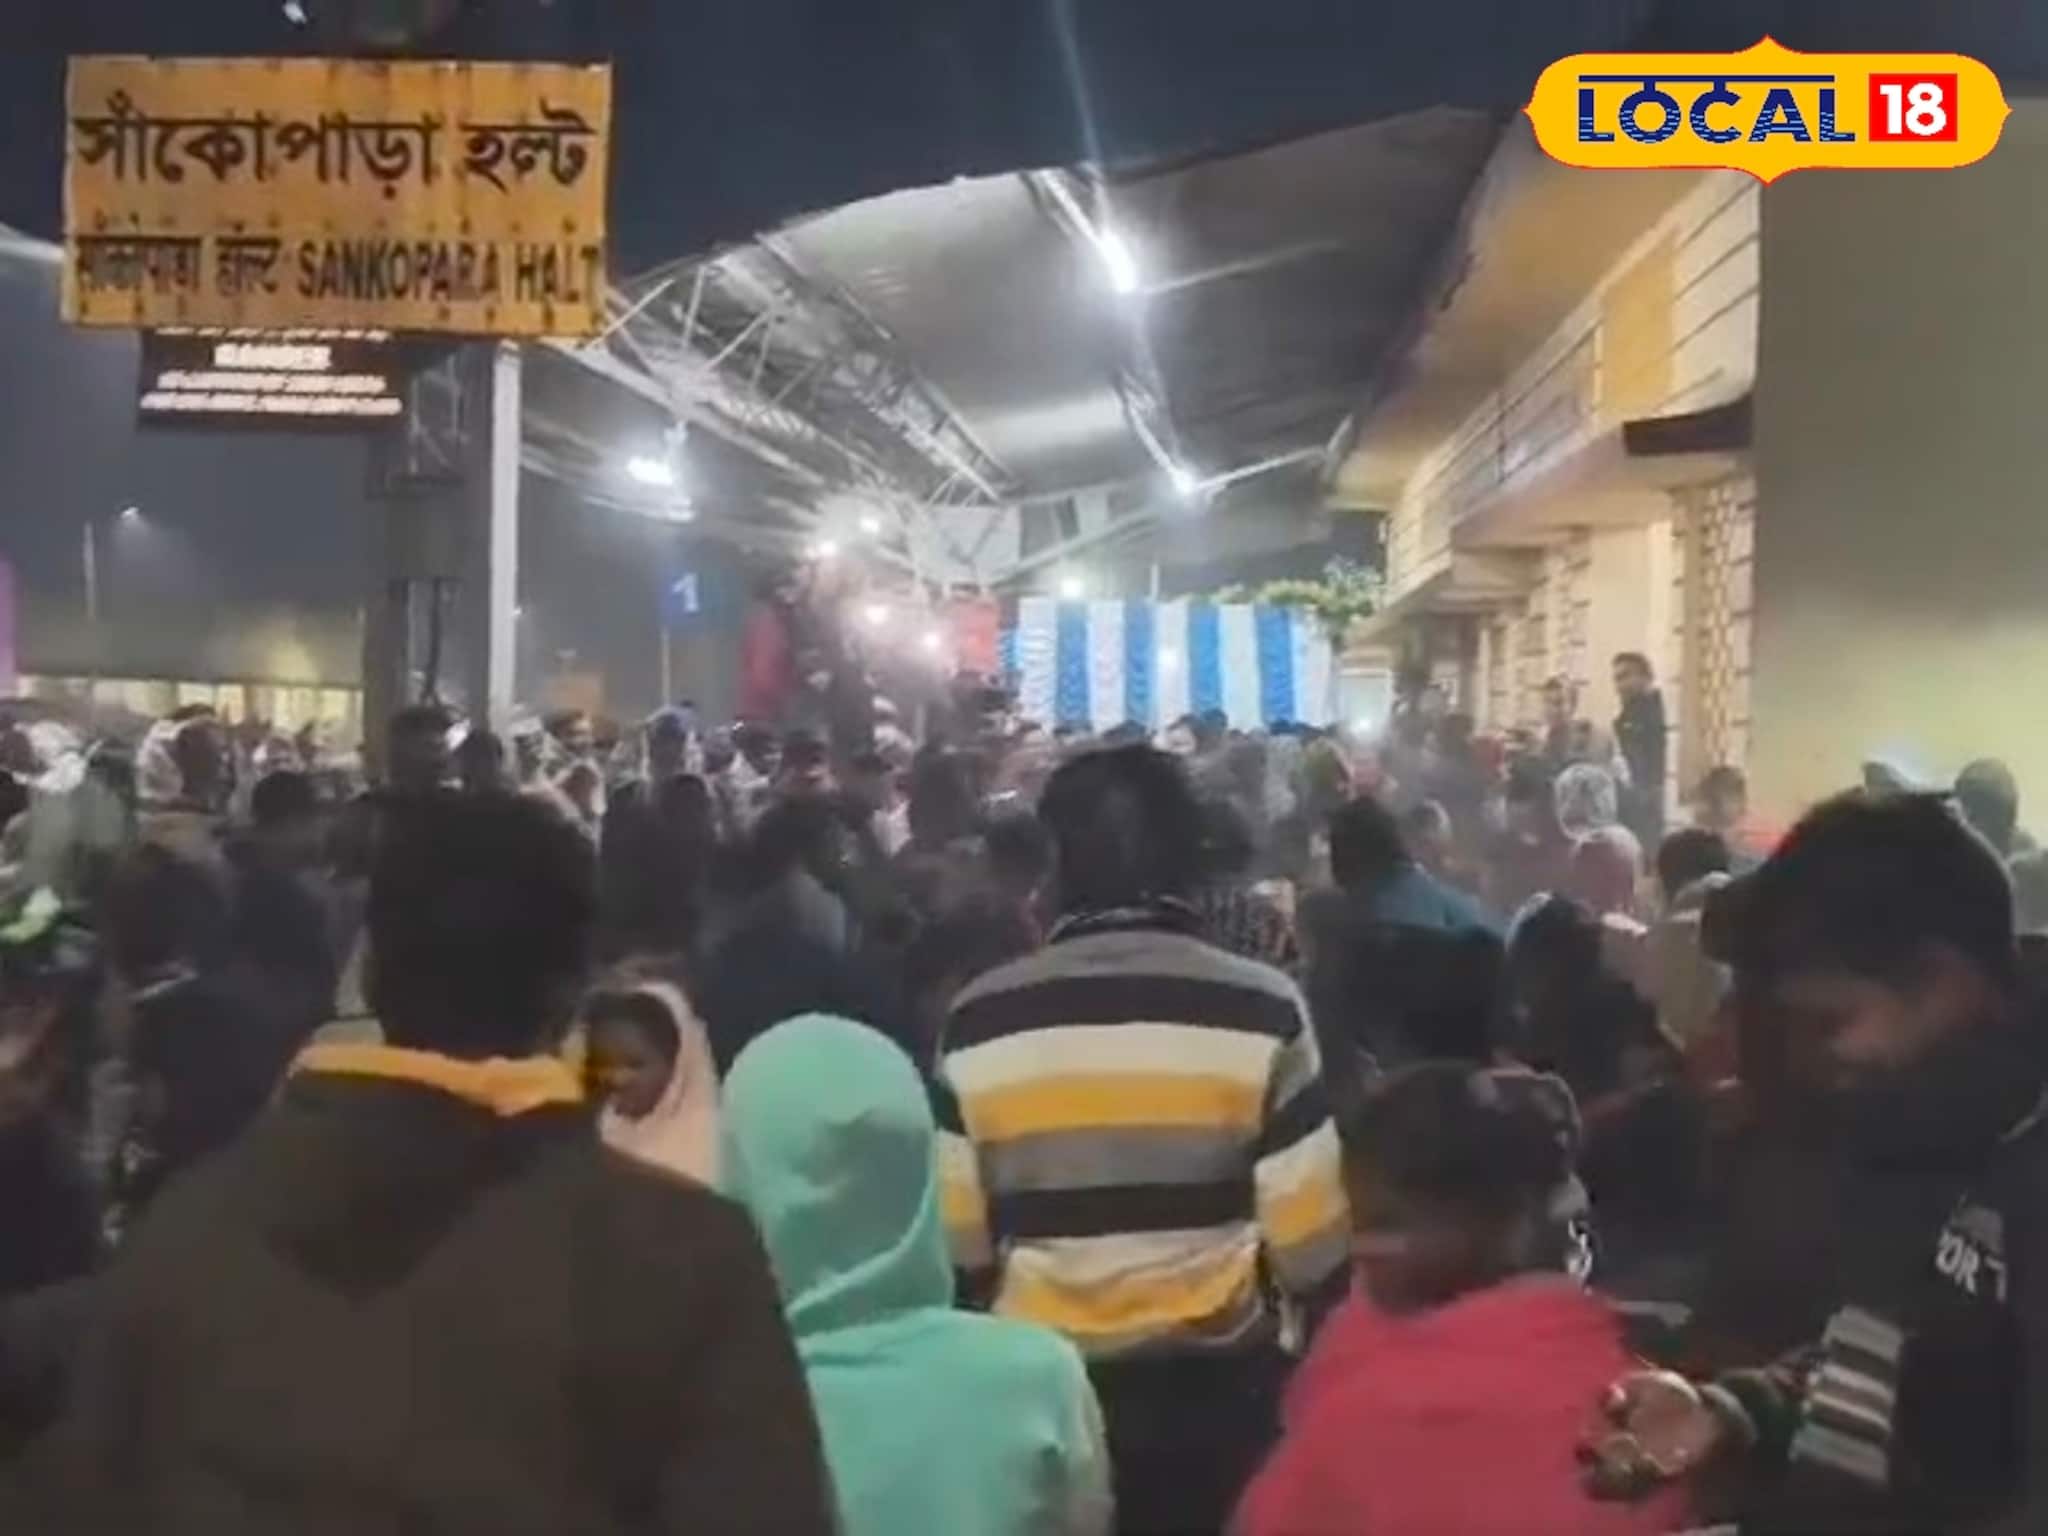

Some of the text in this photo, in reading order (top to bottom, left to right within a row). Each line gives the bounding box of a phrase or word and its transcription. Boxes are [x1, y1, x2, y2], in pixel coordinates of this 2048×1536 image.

[72, 90, 596, 198] সাঁকোপাড়া হল্ট
[297, 240, 600, 302] SANKOPARA HALT
